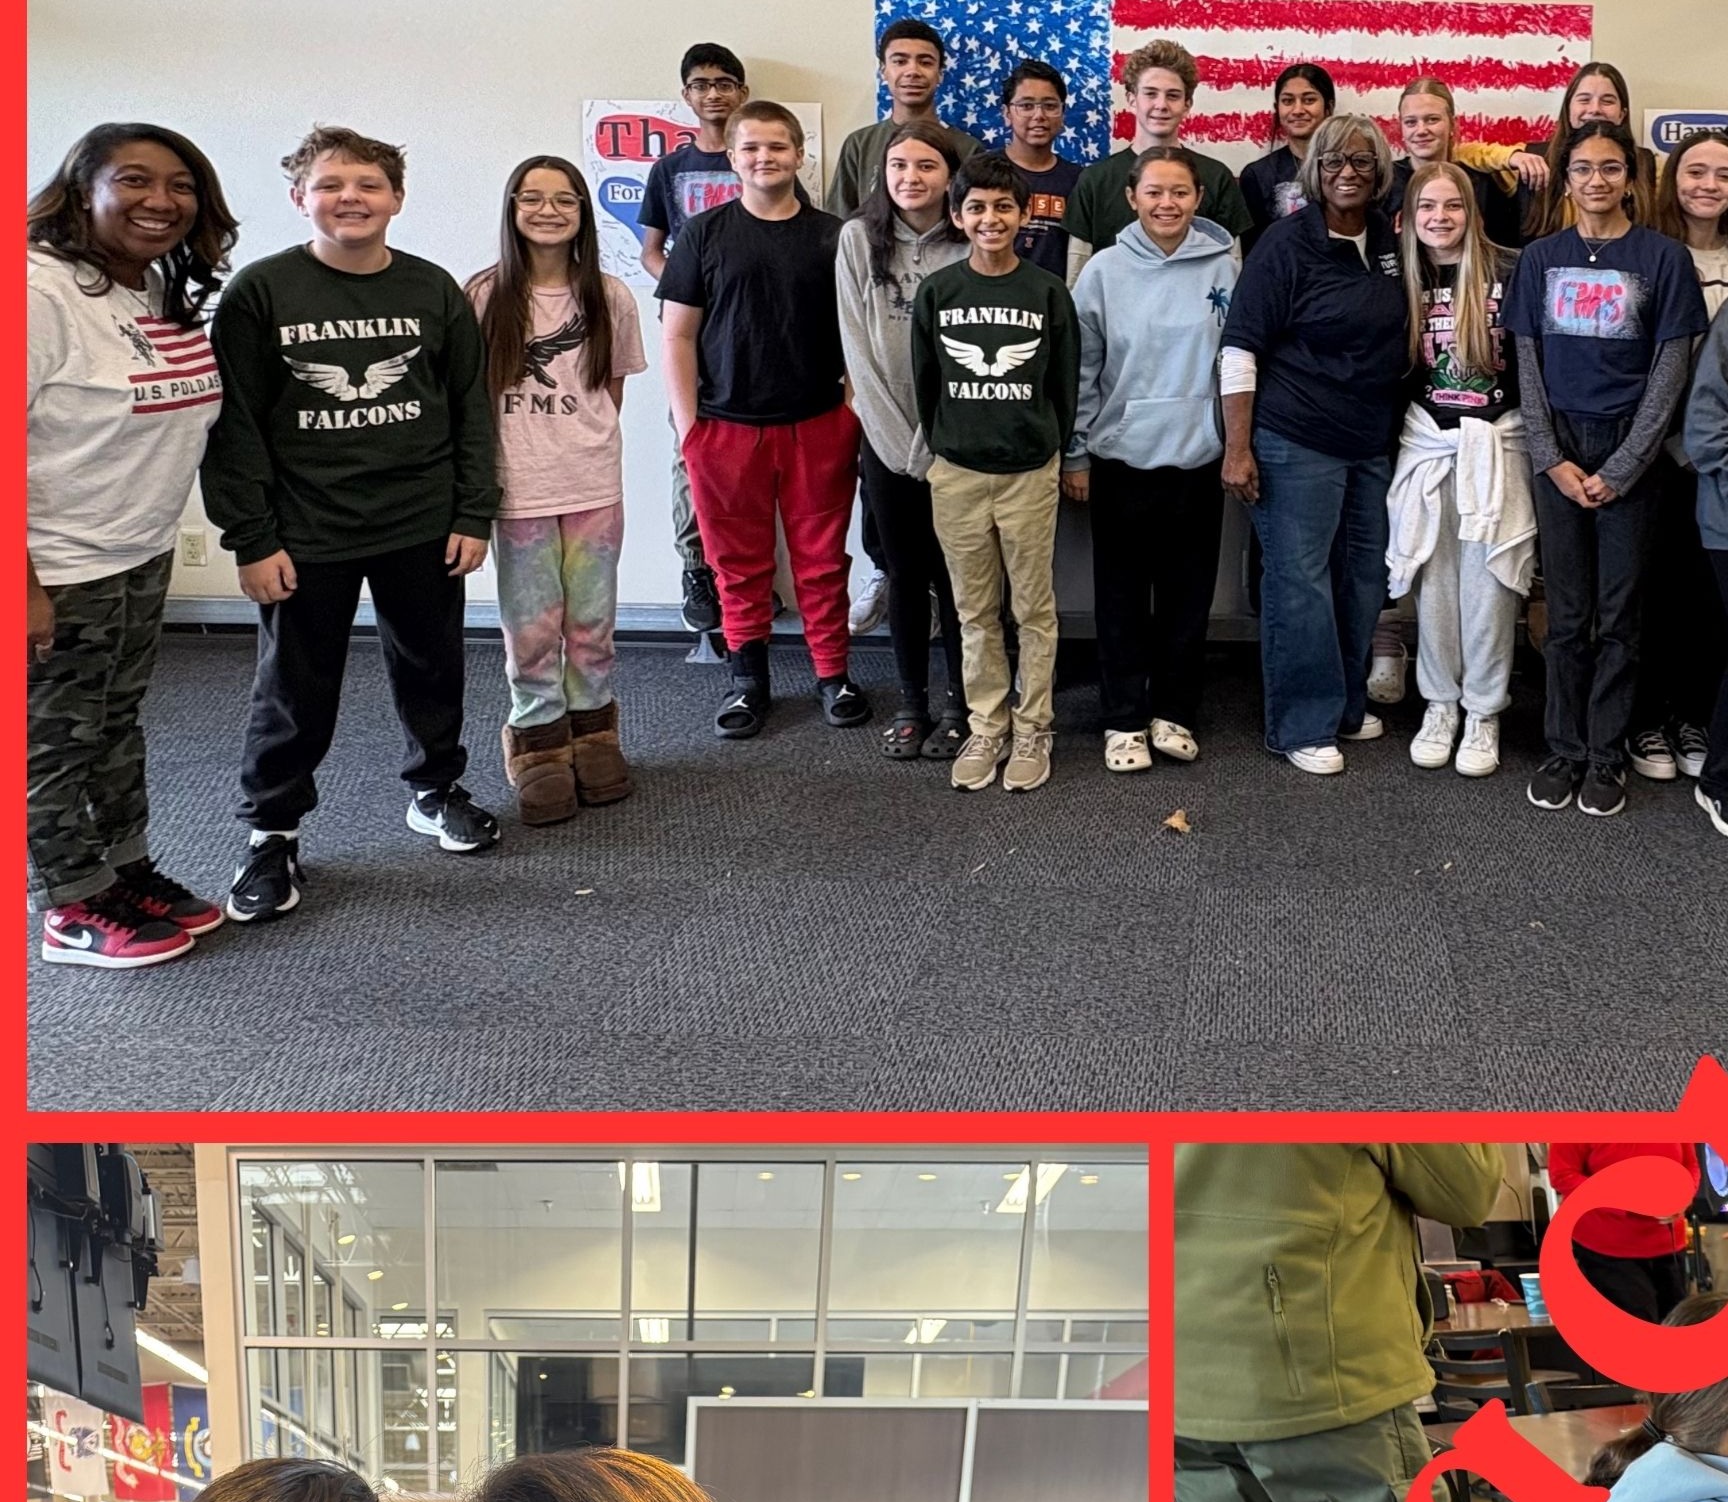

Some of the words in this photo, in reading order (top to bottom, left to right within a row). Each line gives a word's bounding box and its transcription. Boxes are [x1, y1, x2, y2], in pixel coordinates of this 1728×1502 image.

[600, 119, 697, 158] Tha
[610, 184, 644, 200] For
[279, 317, 422, 346] FRANKLIN
[938, 307, 1043, 331] FRANKLIN
[134, 384, 163, 401] U.S.
[948, 381, 1033, 401] FALCONS
[297, 400, 422, 431] FALCONS
[503, 391, 580, 417] FMS
